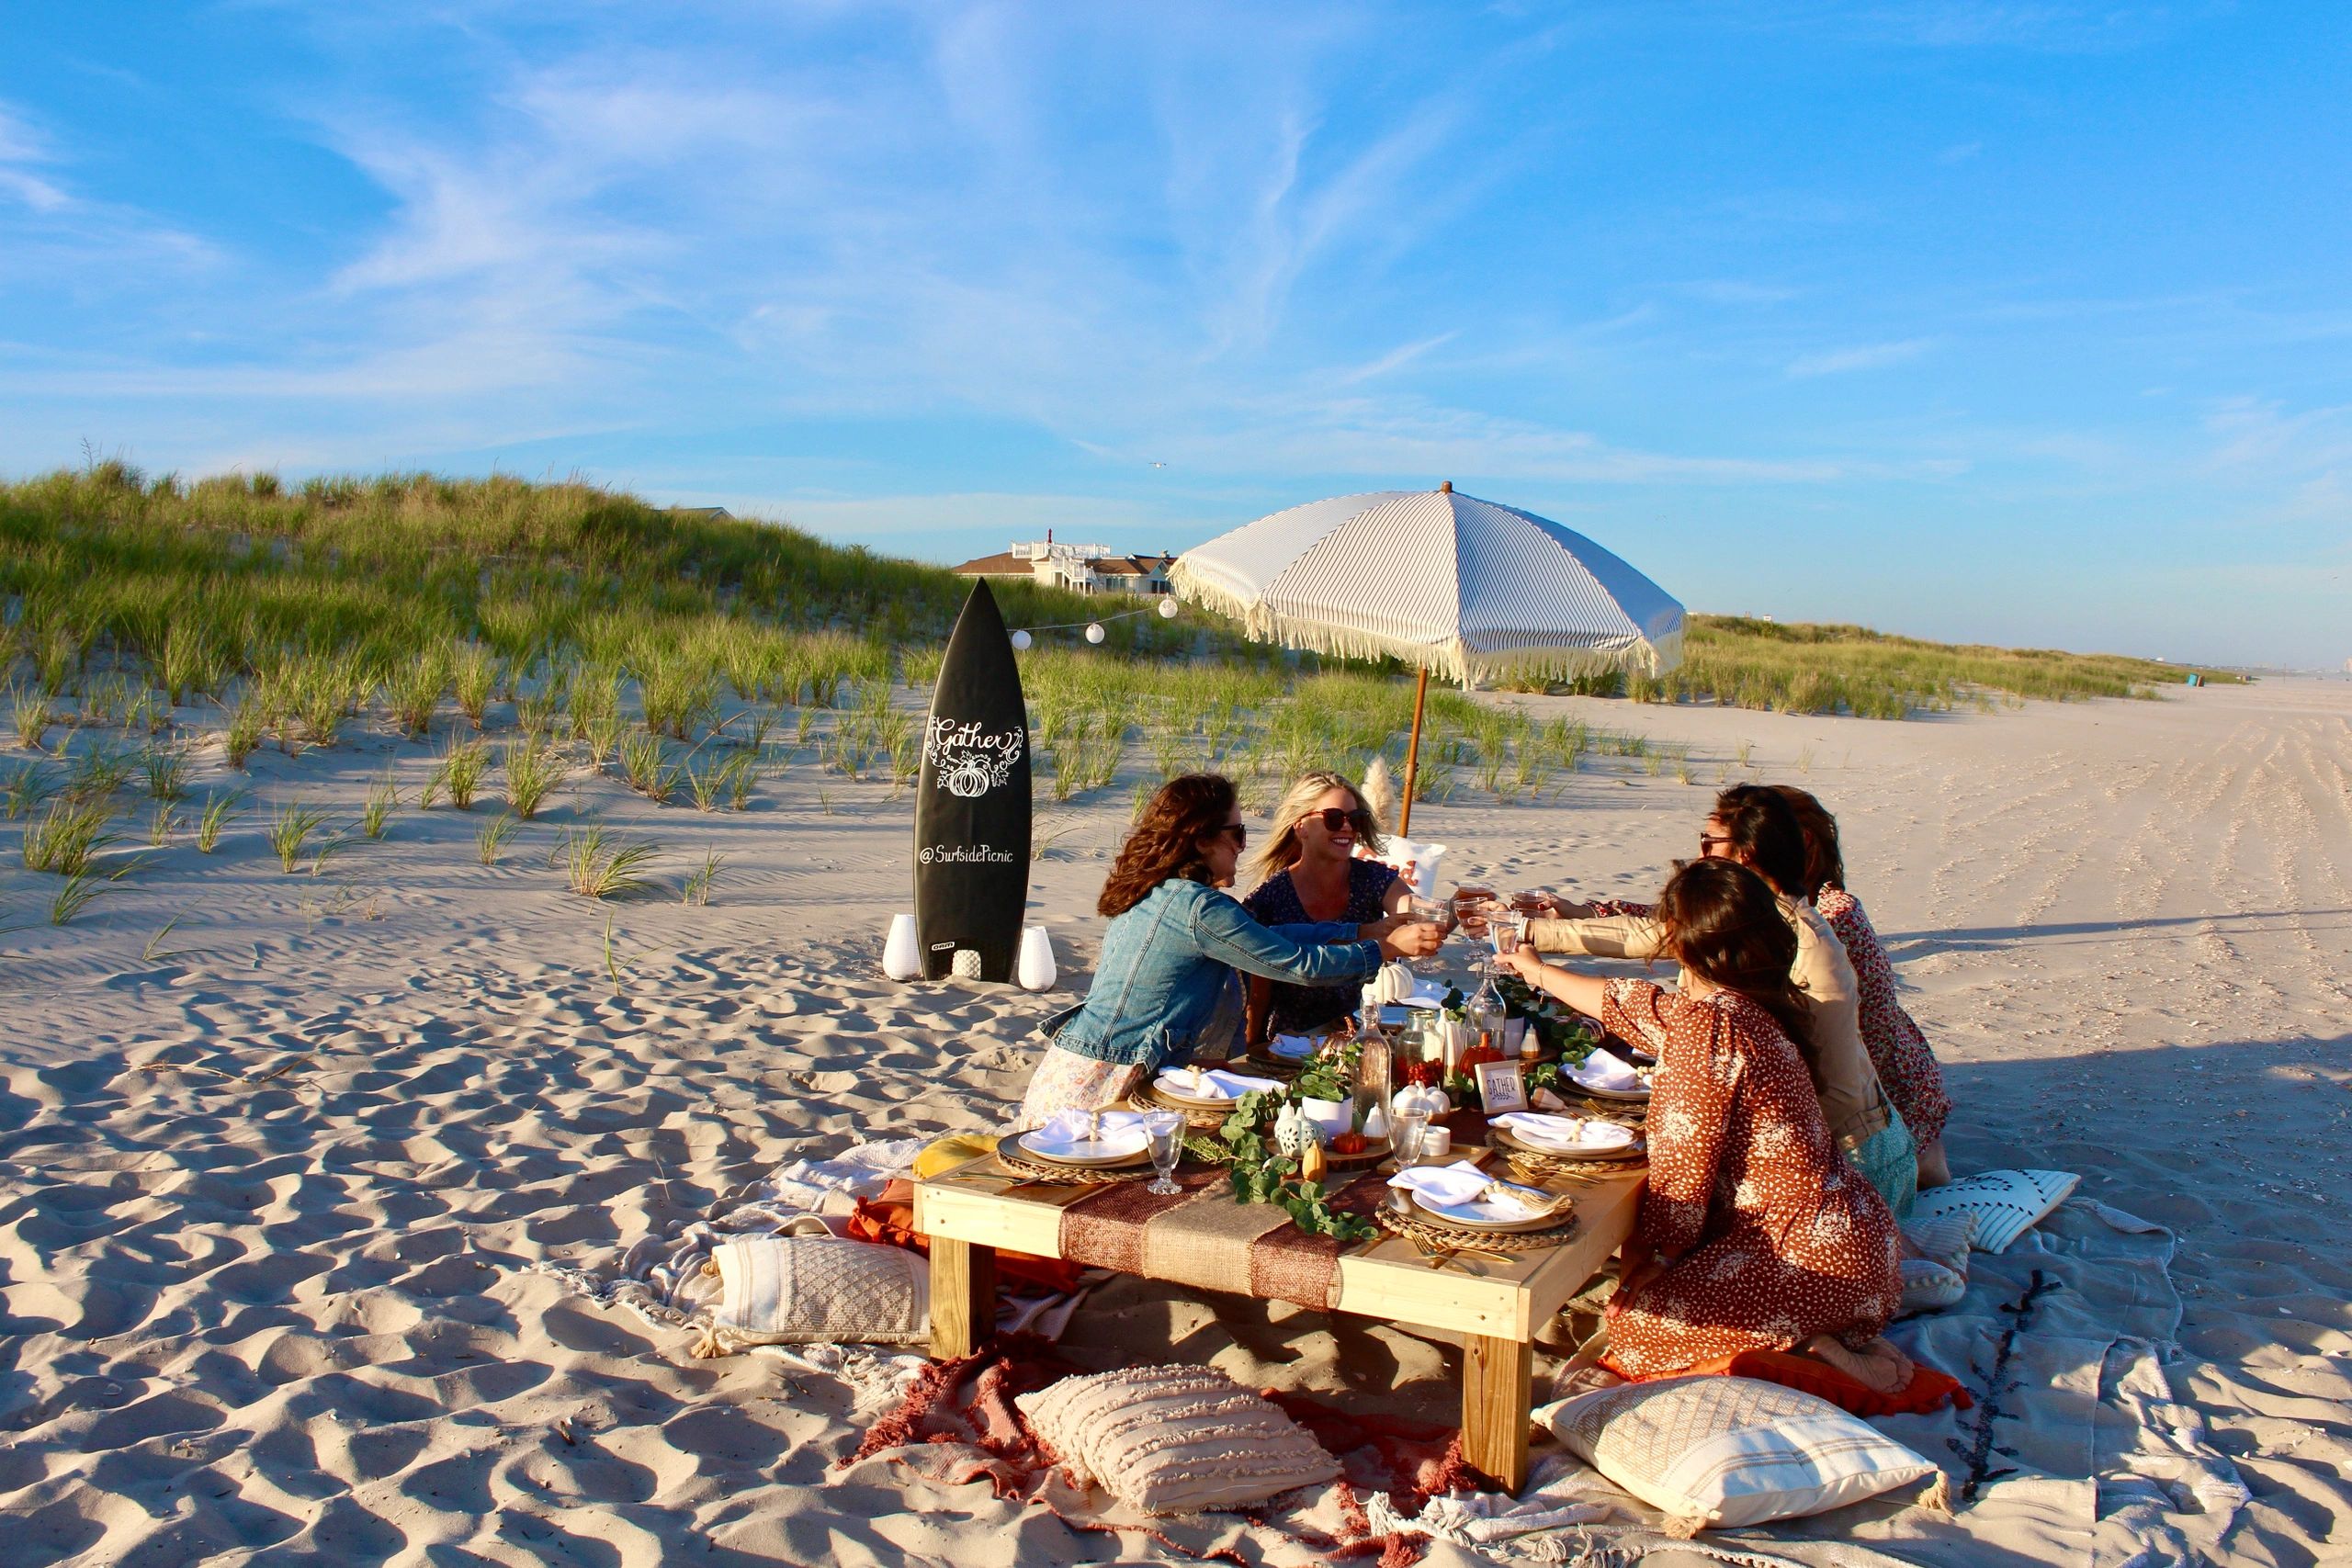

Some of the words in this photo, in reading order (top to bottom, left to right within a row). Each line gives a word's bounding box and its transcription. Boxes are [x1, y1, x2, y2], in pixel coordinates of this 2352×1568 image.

[935, 716, 1013, 756] Gather
[919, 844, 1014, 865] @SurfsidePicnic
[1487, 1077, 1516, 1095] GATHER
